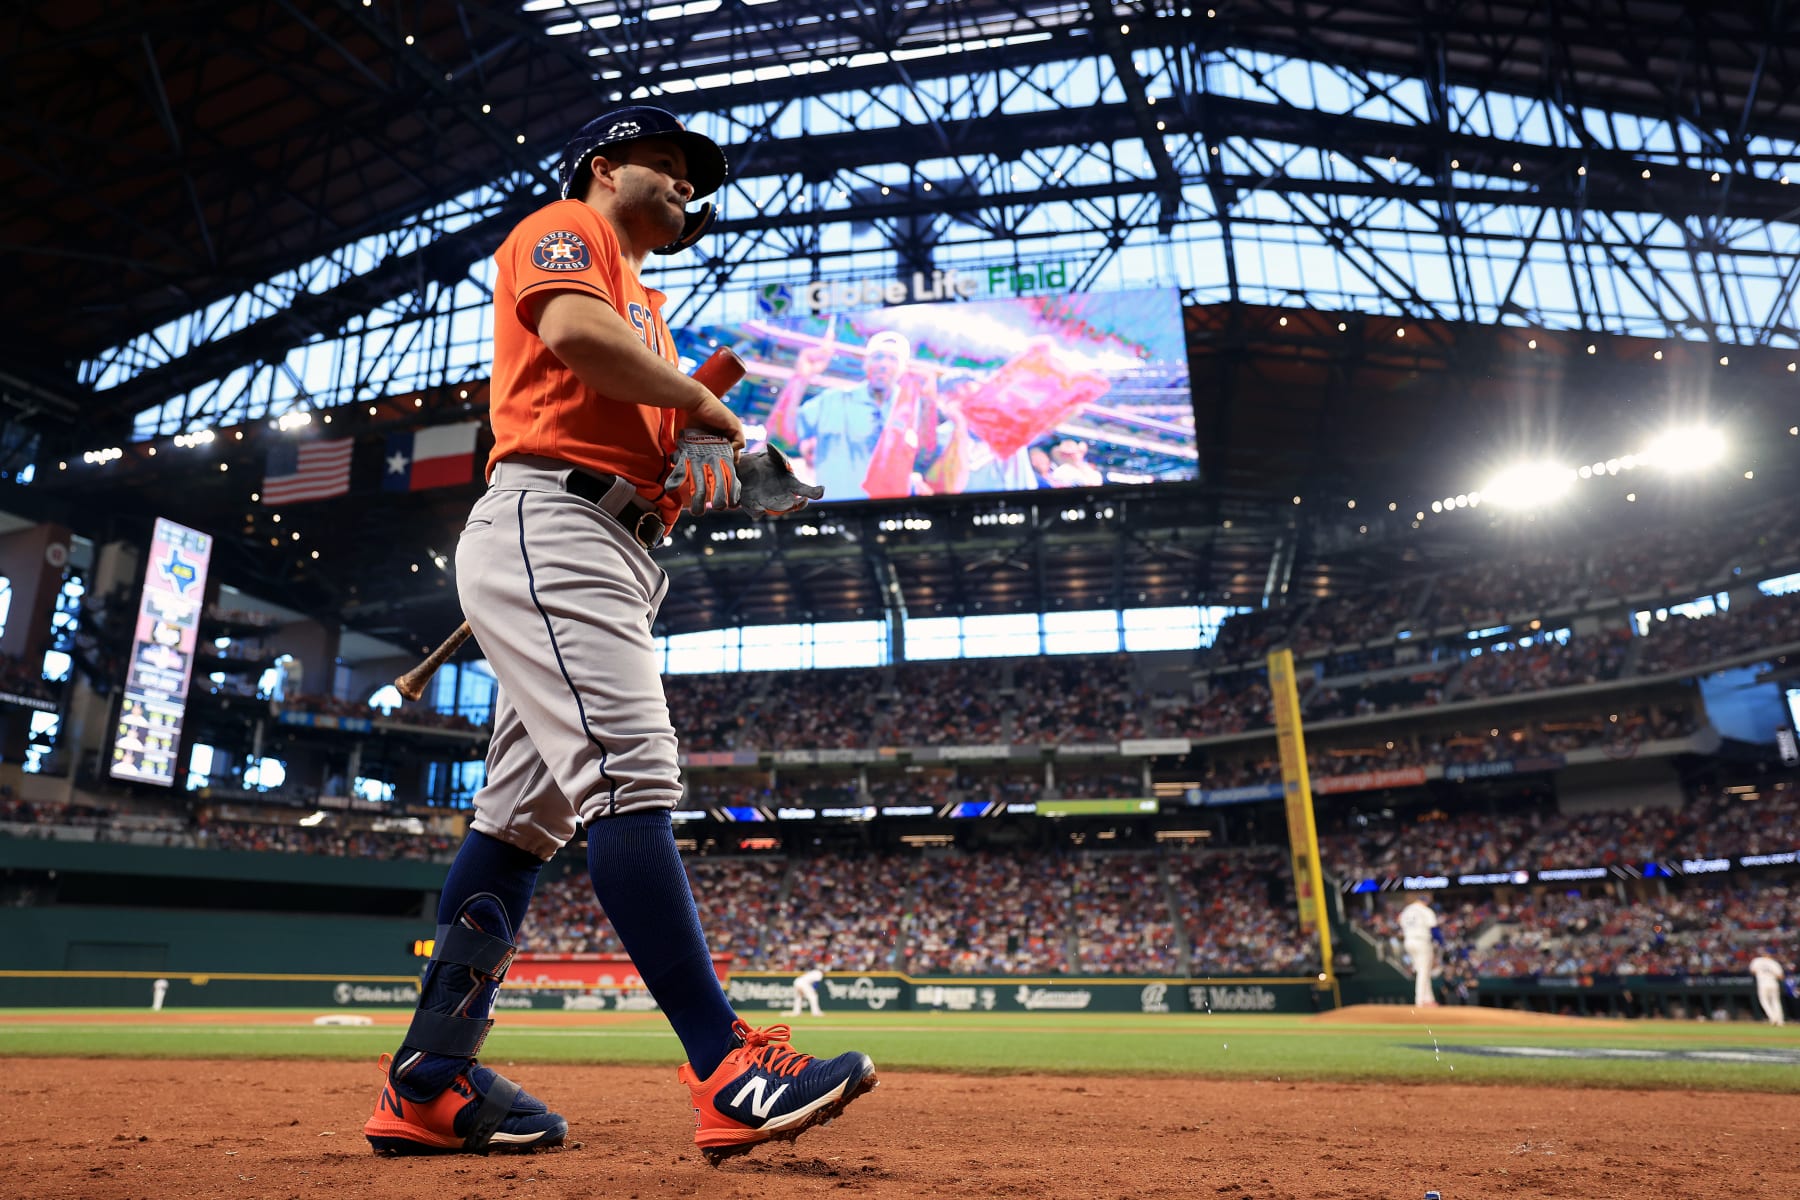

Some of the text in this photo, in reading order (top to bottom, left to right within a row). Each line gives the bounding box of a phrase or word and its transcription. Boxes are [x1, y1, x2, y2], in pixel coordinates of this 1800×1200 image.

[538, 231, 585, 247] HOUSTON
[550, 243, 574, 259] H
[541, 261, 585, 269] ASTROS
[806, 260, 1066, 310] Globe Life Field
[353, 985, 391, 1003] Globe
[1209, 986, 1275, 1010] Mobile
